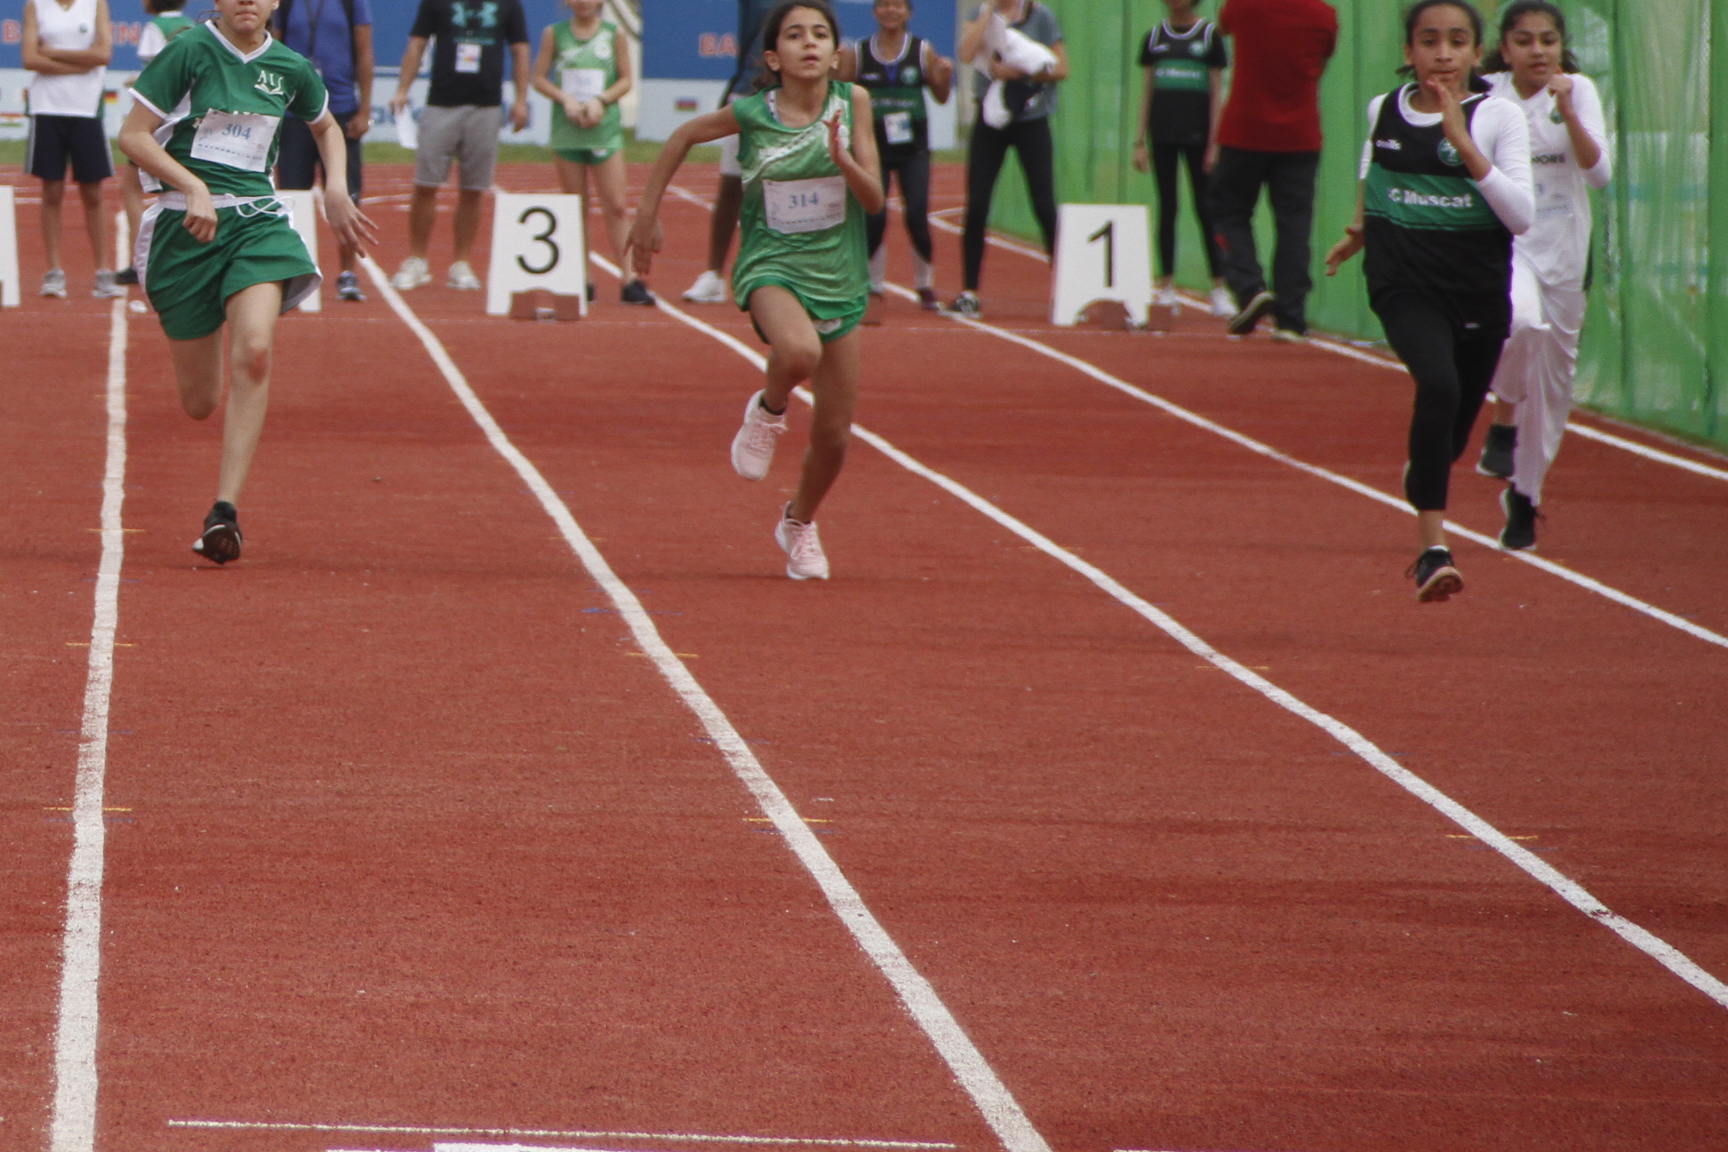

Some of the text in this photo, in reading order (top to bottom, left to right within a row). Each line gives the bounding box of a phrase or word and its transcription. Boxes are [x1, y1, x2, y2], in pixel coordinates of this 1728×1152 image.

[222, 123, 252, 140] 304
[789, 192, 819, 209] 314
[1403, 189, 1472, 207] Muscat
[516, 206, 559, 275] 3
[1088, 220, 1113, 288] 1
